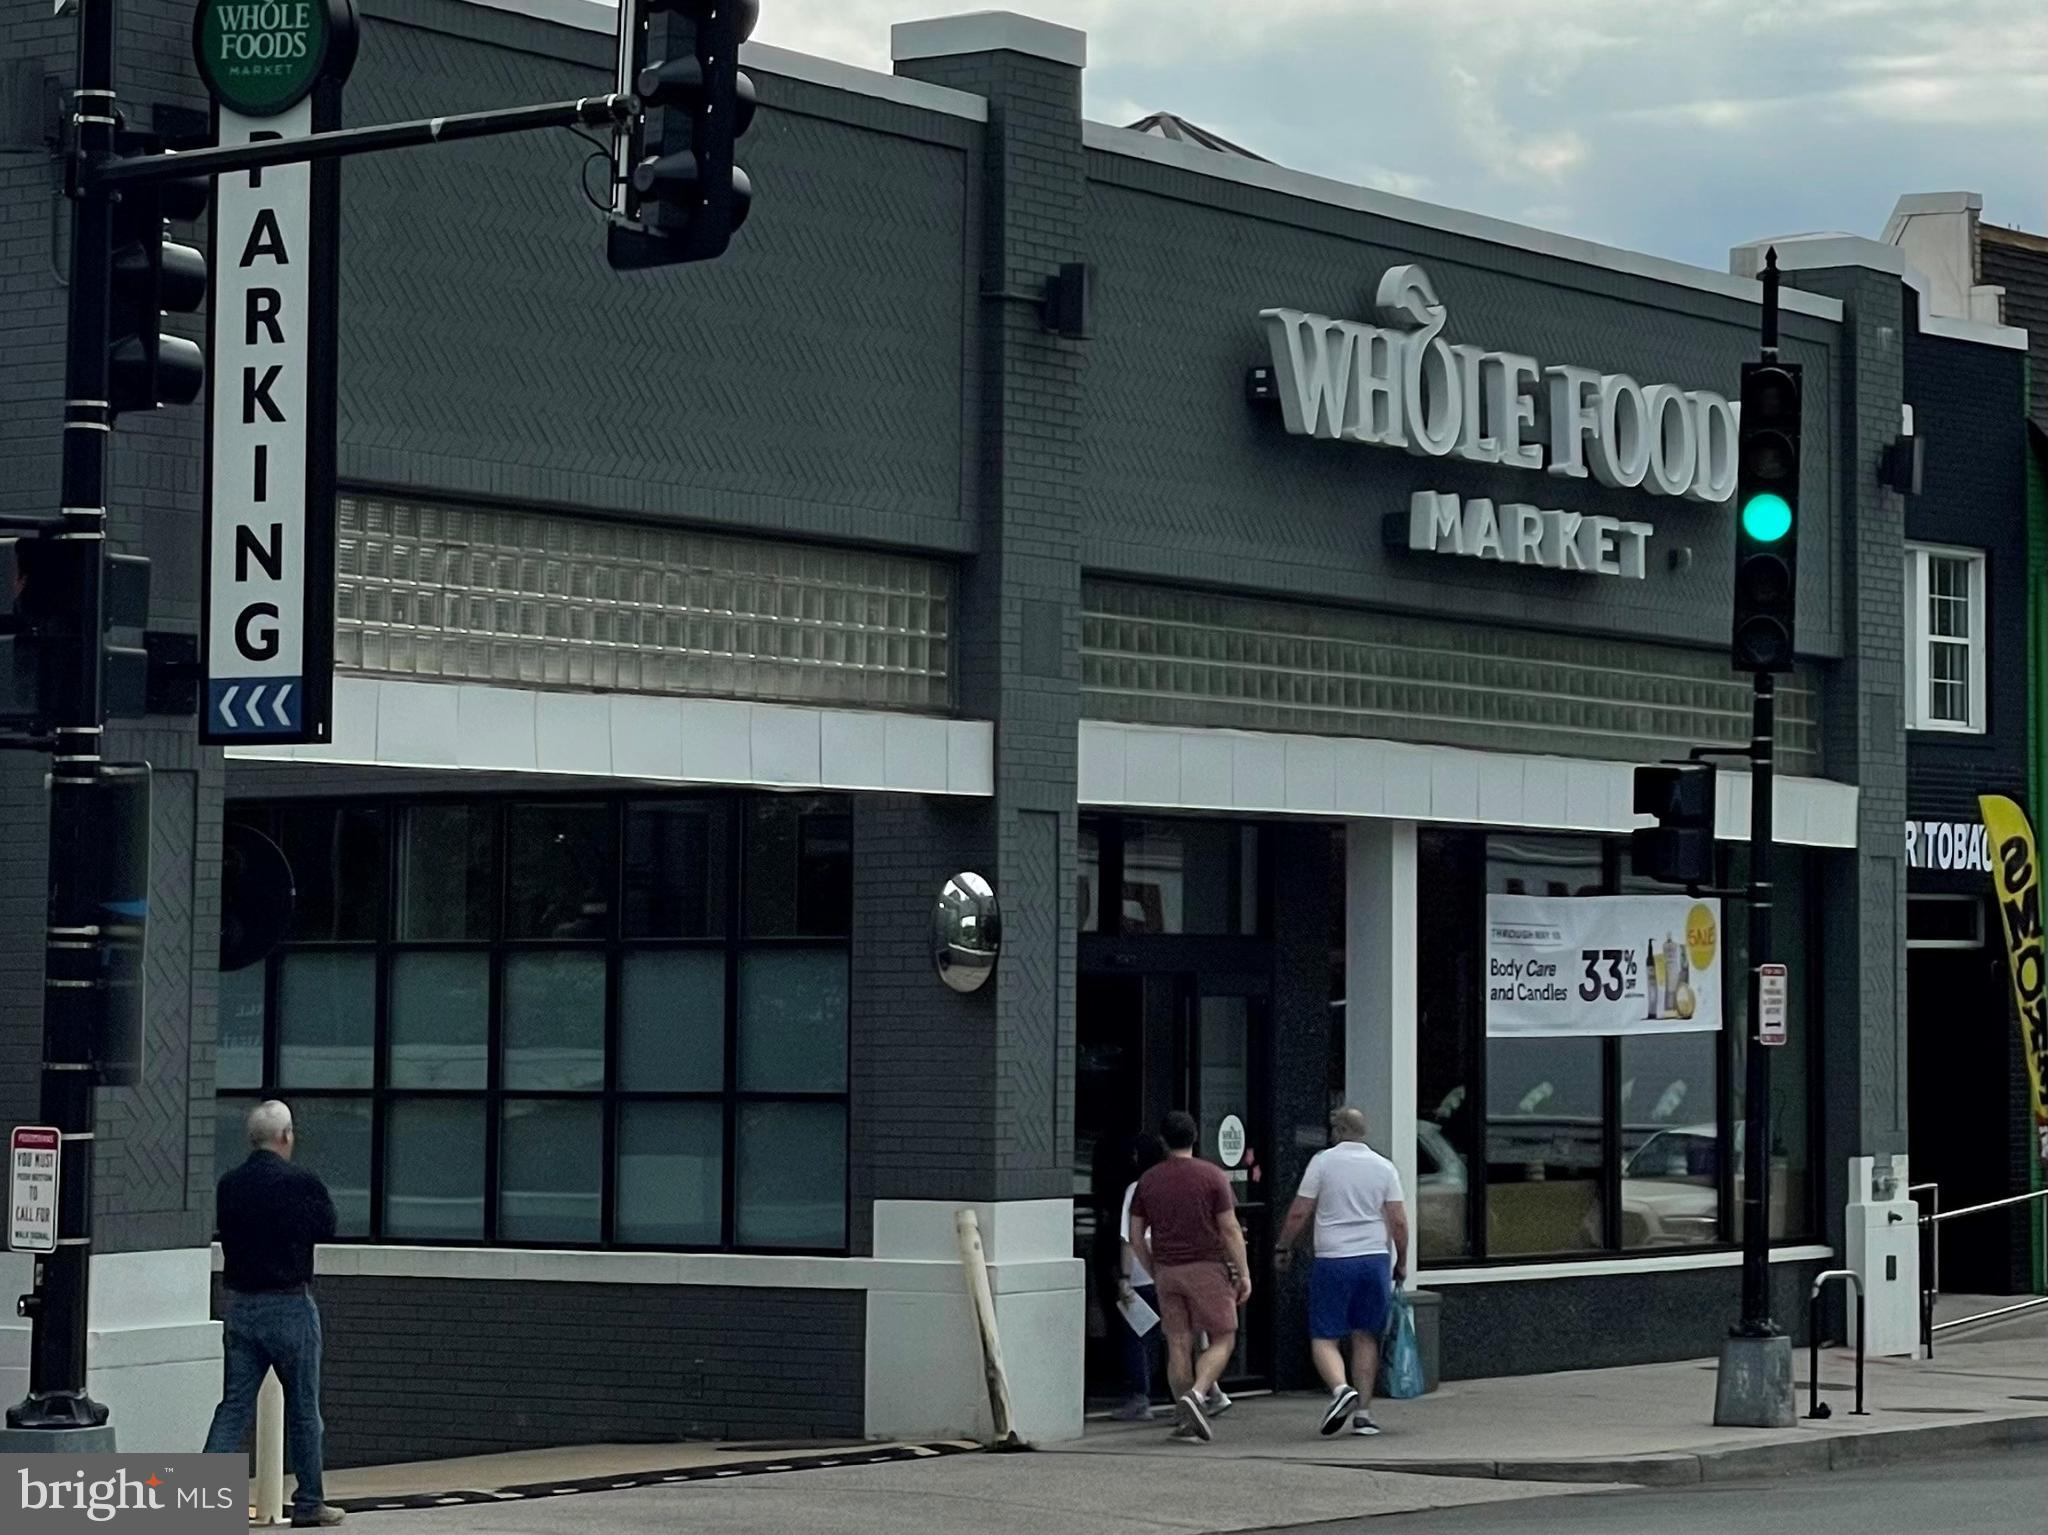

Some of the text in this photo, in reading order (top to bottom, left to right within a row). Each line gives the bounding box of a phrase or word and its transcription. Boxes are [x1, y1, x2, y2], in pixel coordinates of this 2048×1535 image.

[216, 0, 310, 31] WHOLE
[220, 31, 307, 60] FOODS
[229, 63, 293, 76] MARKET
[1259, 265, 1741, 503] WHOLE FOOD
[1409, 490, 1653, 579] MARKET
[1688, 926, 1715, 945] SALE
[1491, 958, 1557, 981] Body Care
[1490, 982, 1568, 1001] and Candles
[17, 1152, 32, 1167] YOU
[29, 1185, 38, 1201] TO
[15, 1206, 51, 1223] CALL FOR
